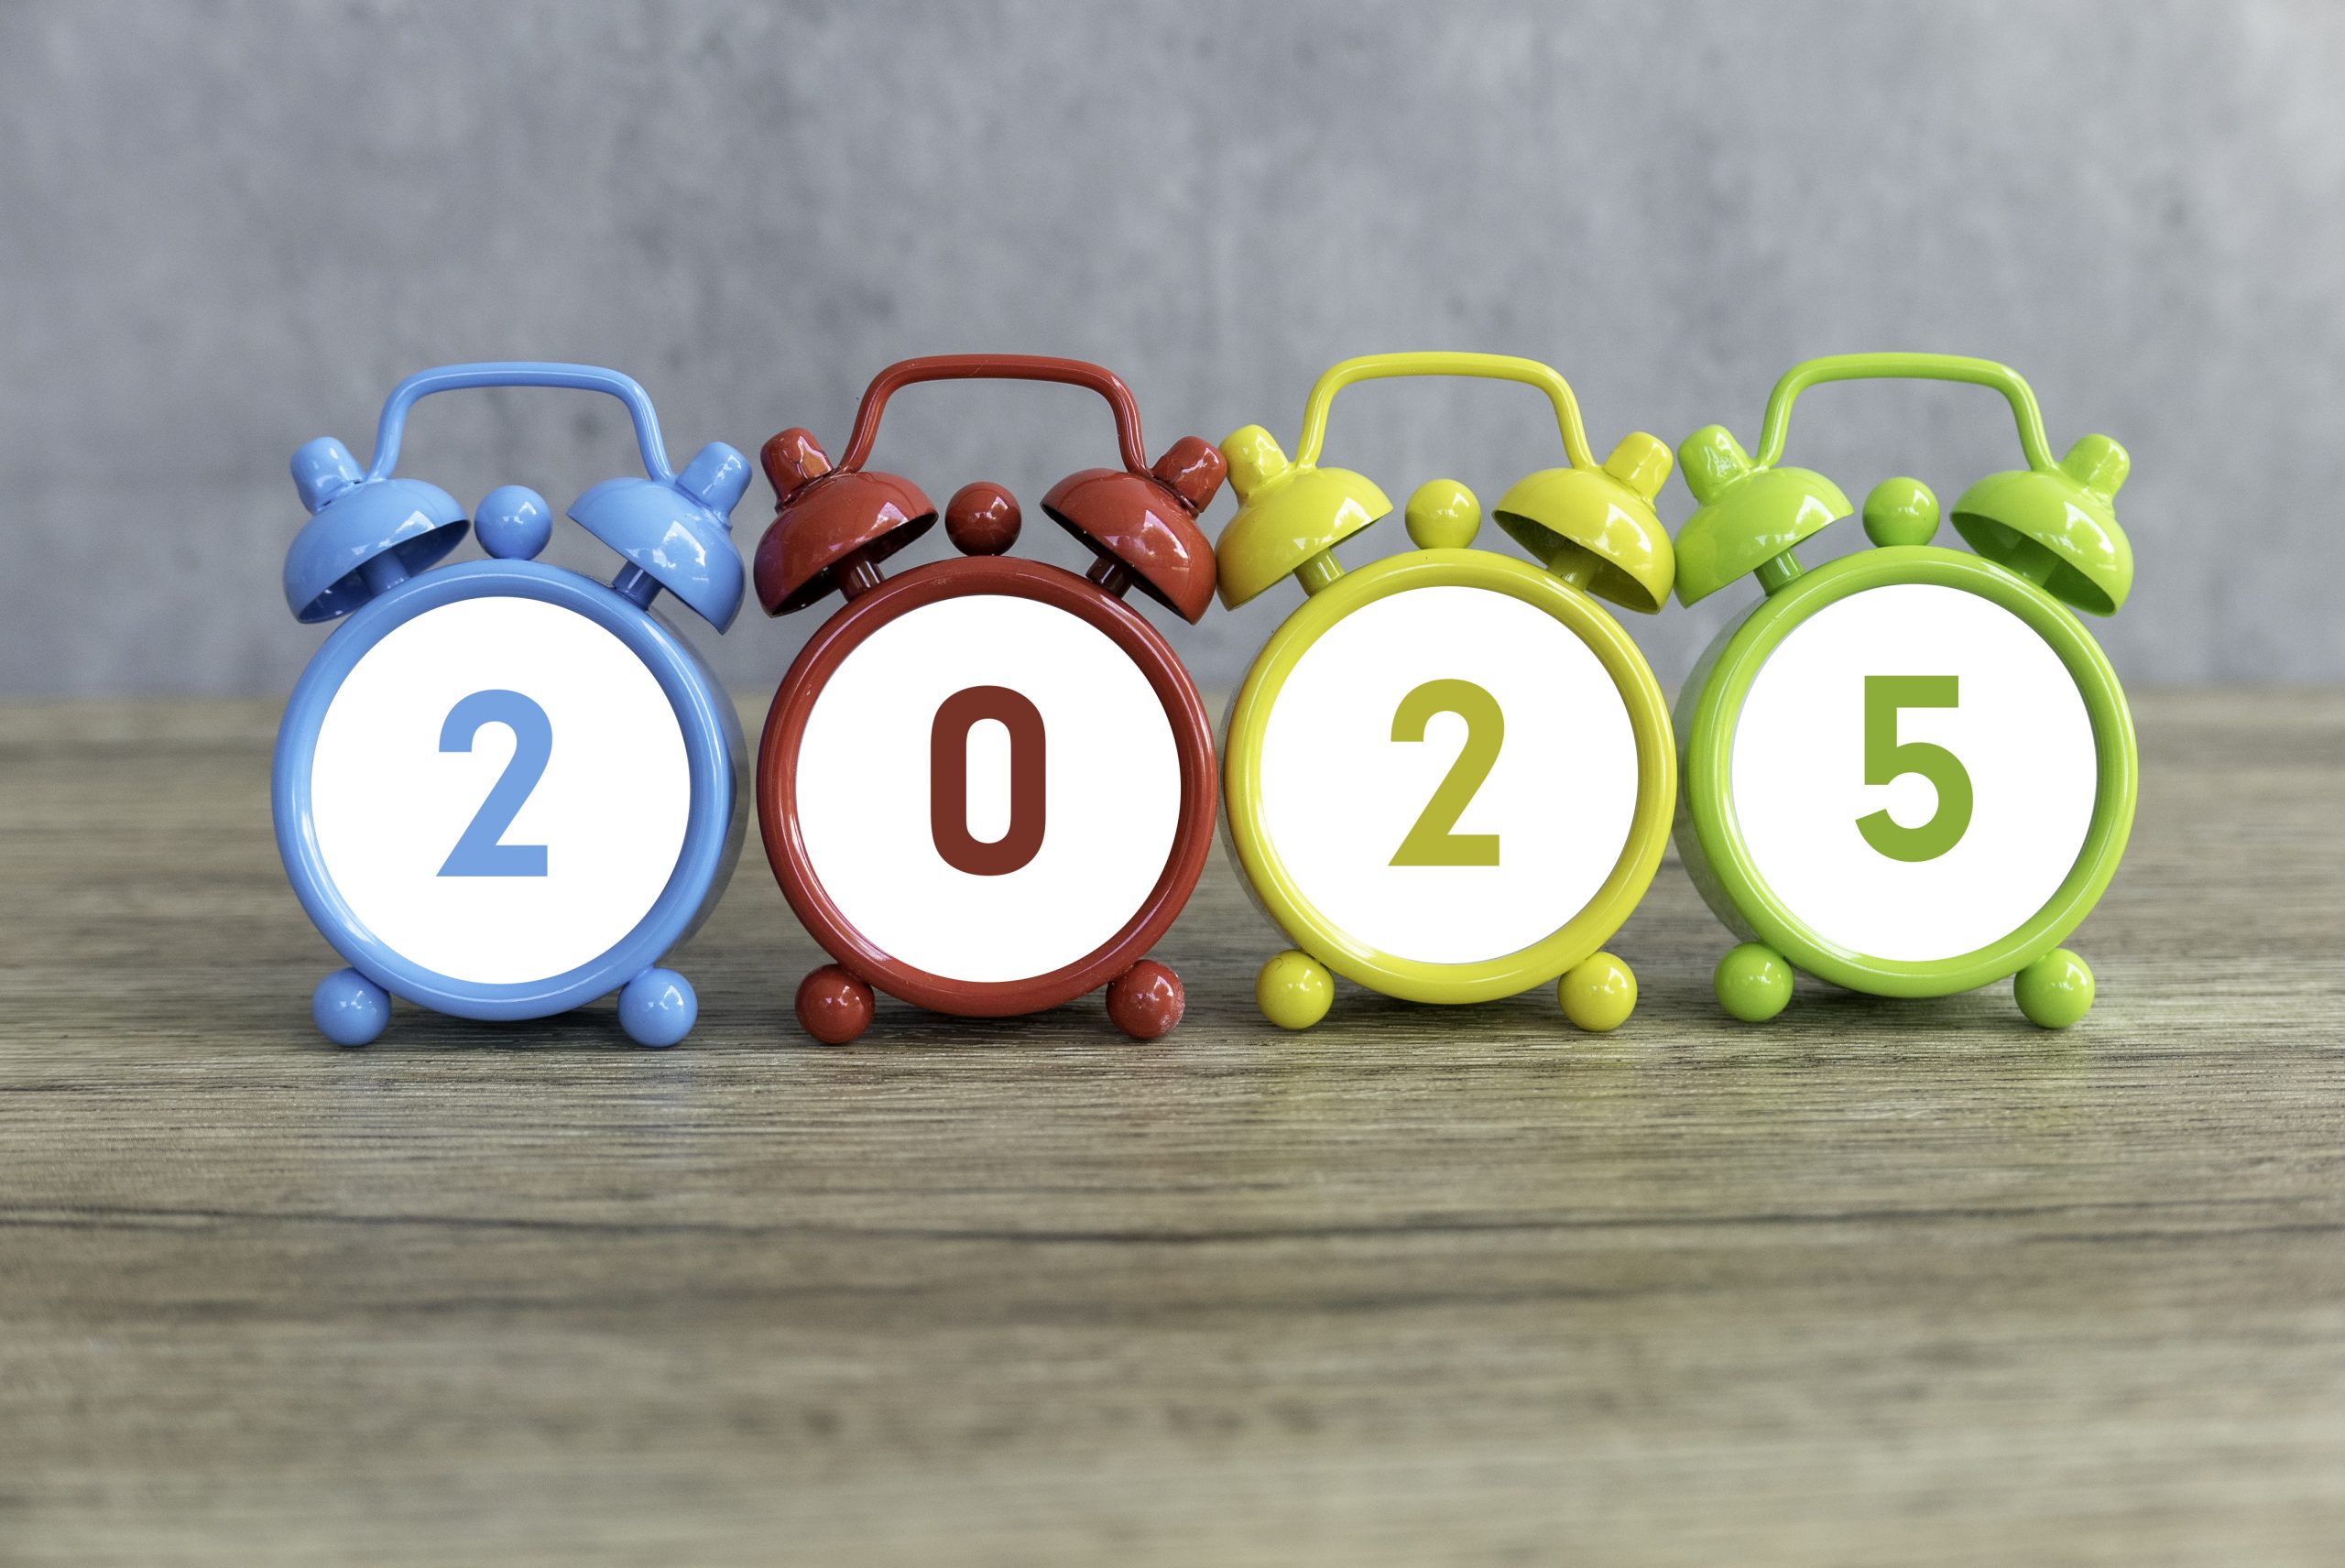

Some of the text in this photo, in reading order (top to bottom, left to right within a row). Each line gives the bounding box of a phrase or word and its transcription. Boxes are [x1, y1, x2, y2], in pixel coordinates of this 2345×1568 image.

[436, 690, 553, 877] 2
[931, 685, 1046, 877] 0
[1388, 679, 1505, 866] 2
[1855, 675, 1974, 863] 5
